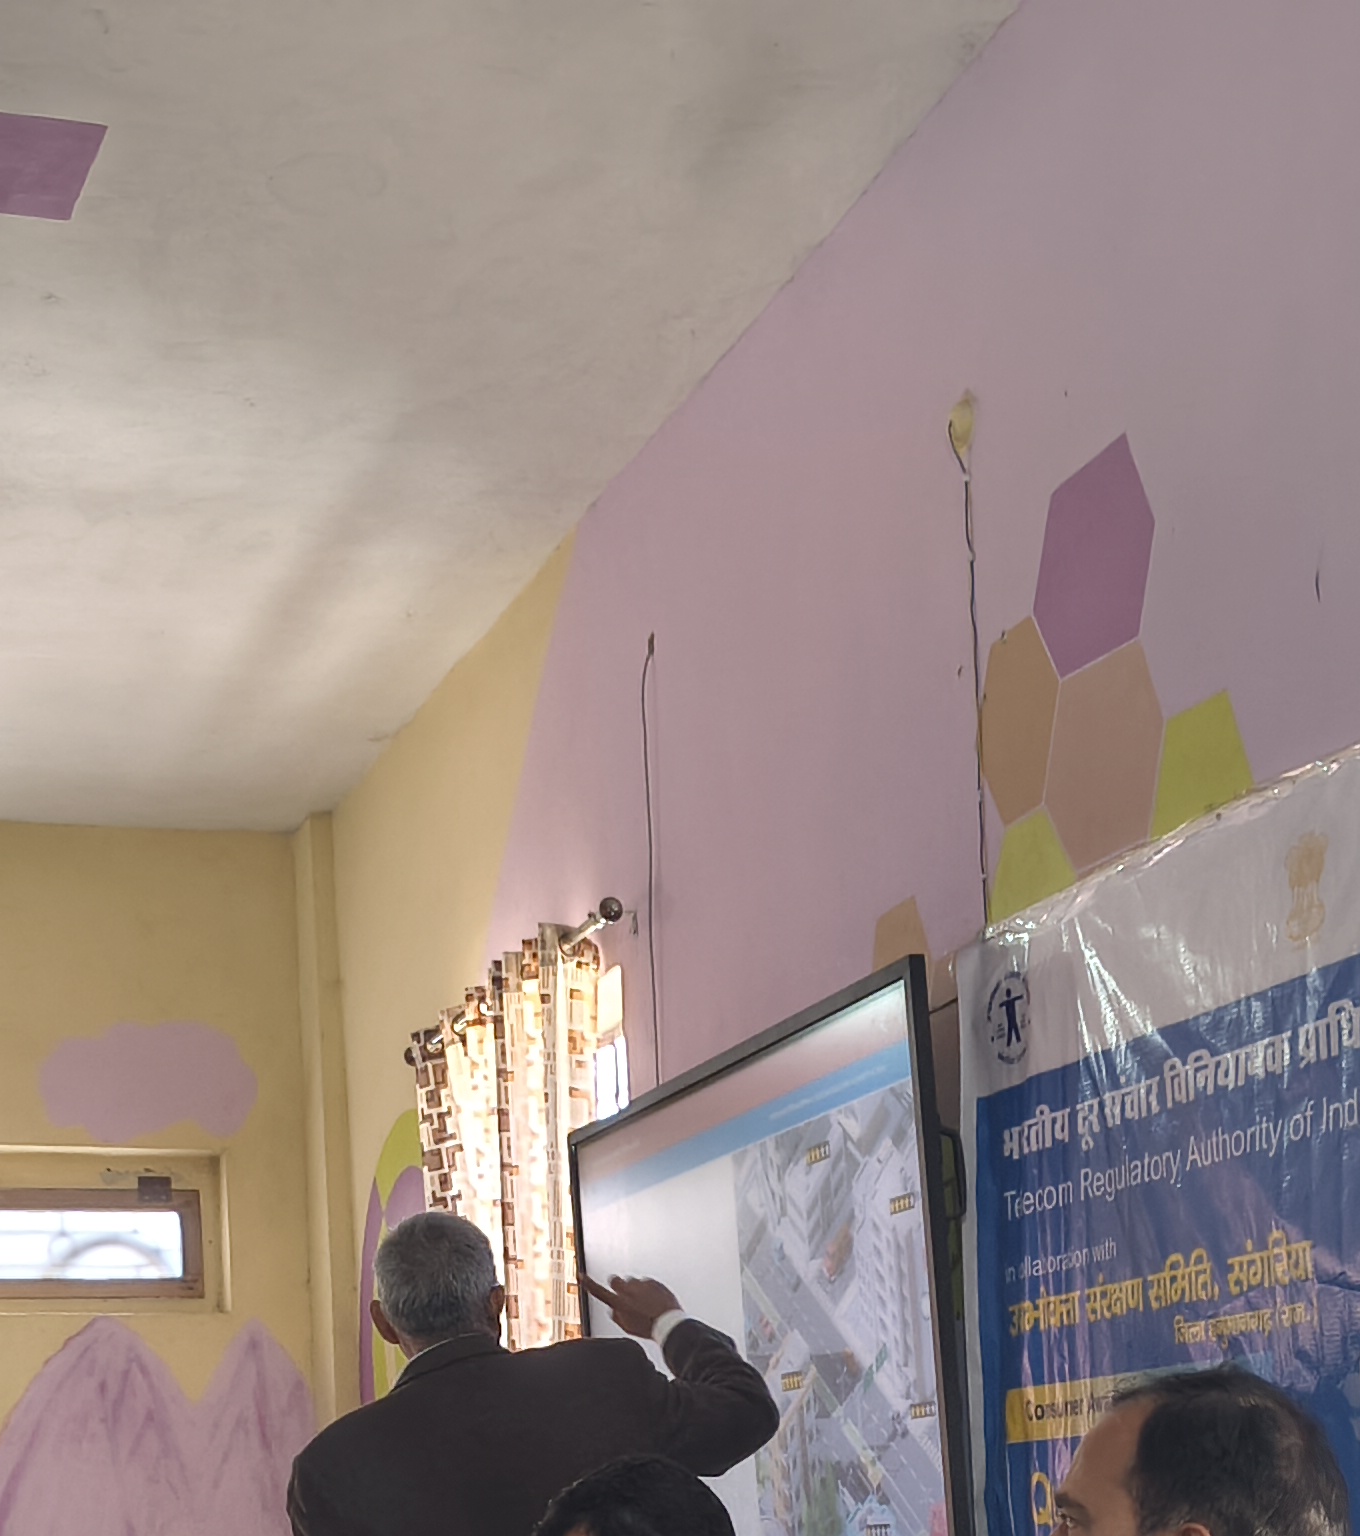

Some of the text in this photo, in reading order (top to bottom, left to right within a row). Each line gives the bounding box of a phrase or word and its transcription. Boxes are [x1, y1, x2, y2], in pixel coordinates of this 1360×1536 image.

[1076, 1098, 1101, 1152] दूर
[1103, 1073, 1162, 1127] संचार
[1078, 1147, 1181, 1203] Regulatory
[1186, 1117, 1287, 1172] Authority
[1288, 1098, 1315, 1142] of
[1084, 1272, 1144, 1324] संरक्षण
[1148, 1248, 1220, 1312] समिति,
[1227, 1230, 1315, 1297] संगरिया
[1092, 1238, 1117, 1264] with
[1174, 1314, 1206, 1345] जिला
[1025, 1396, 1085, 1422] Consumer
